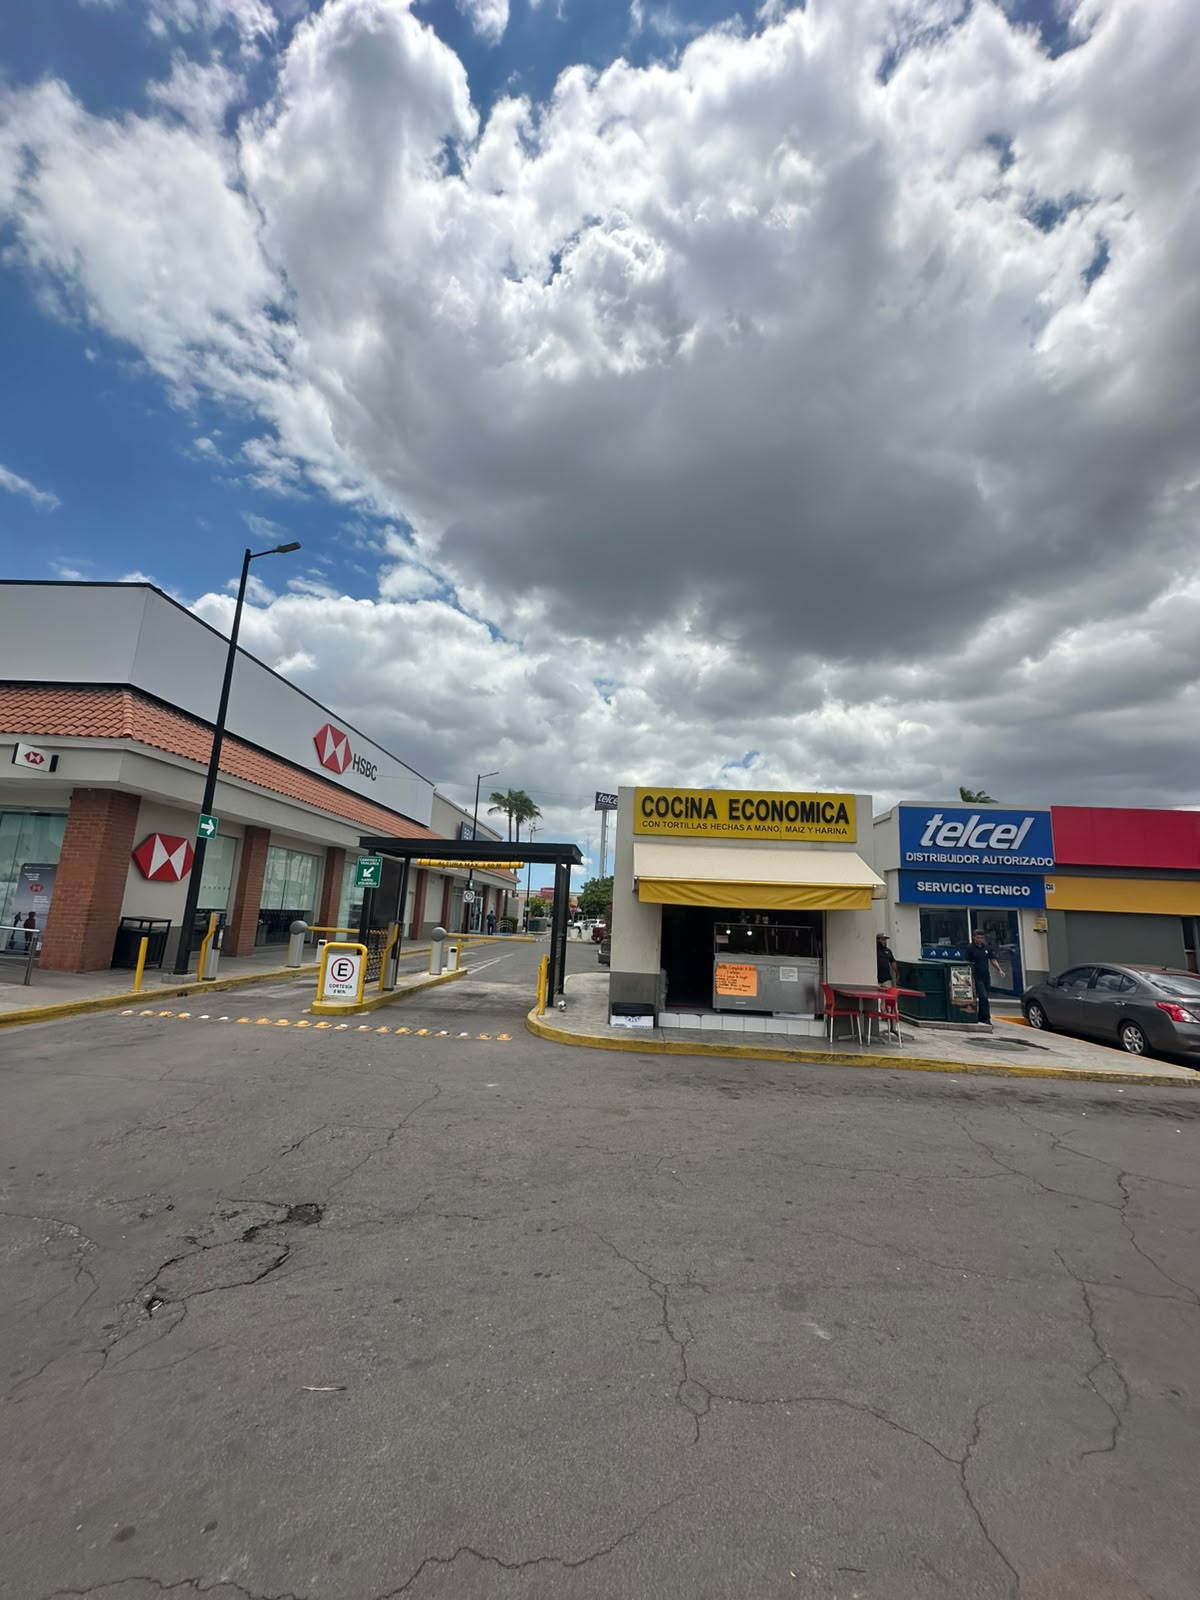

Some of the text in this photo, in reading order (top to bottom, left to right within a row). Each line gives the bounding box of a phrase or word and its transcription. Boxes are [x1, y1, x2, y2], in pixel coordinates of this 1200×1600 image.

[352, 753, 378, 781] HSBC
[598, 794, 618, 805] telce
[641, 795, 850, 825] COCINA ECONOMICA
[642, 820, 660, 828] CON
[663, 821, 708, 830] TORTILLAS
[710, 823, 745, 831] HECHAS
[815, 827, 848, 835] HARINA
[920, 814, 1035, 850] telcel
[905, 852, 1054, 867] DISTRIBUIDOR AUTORIZADO
[917, 881, 1031, 896] SERVICIO TECNICO
[337, 963, 349, 977] E
